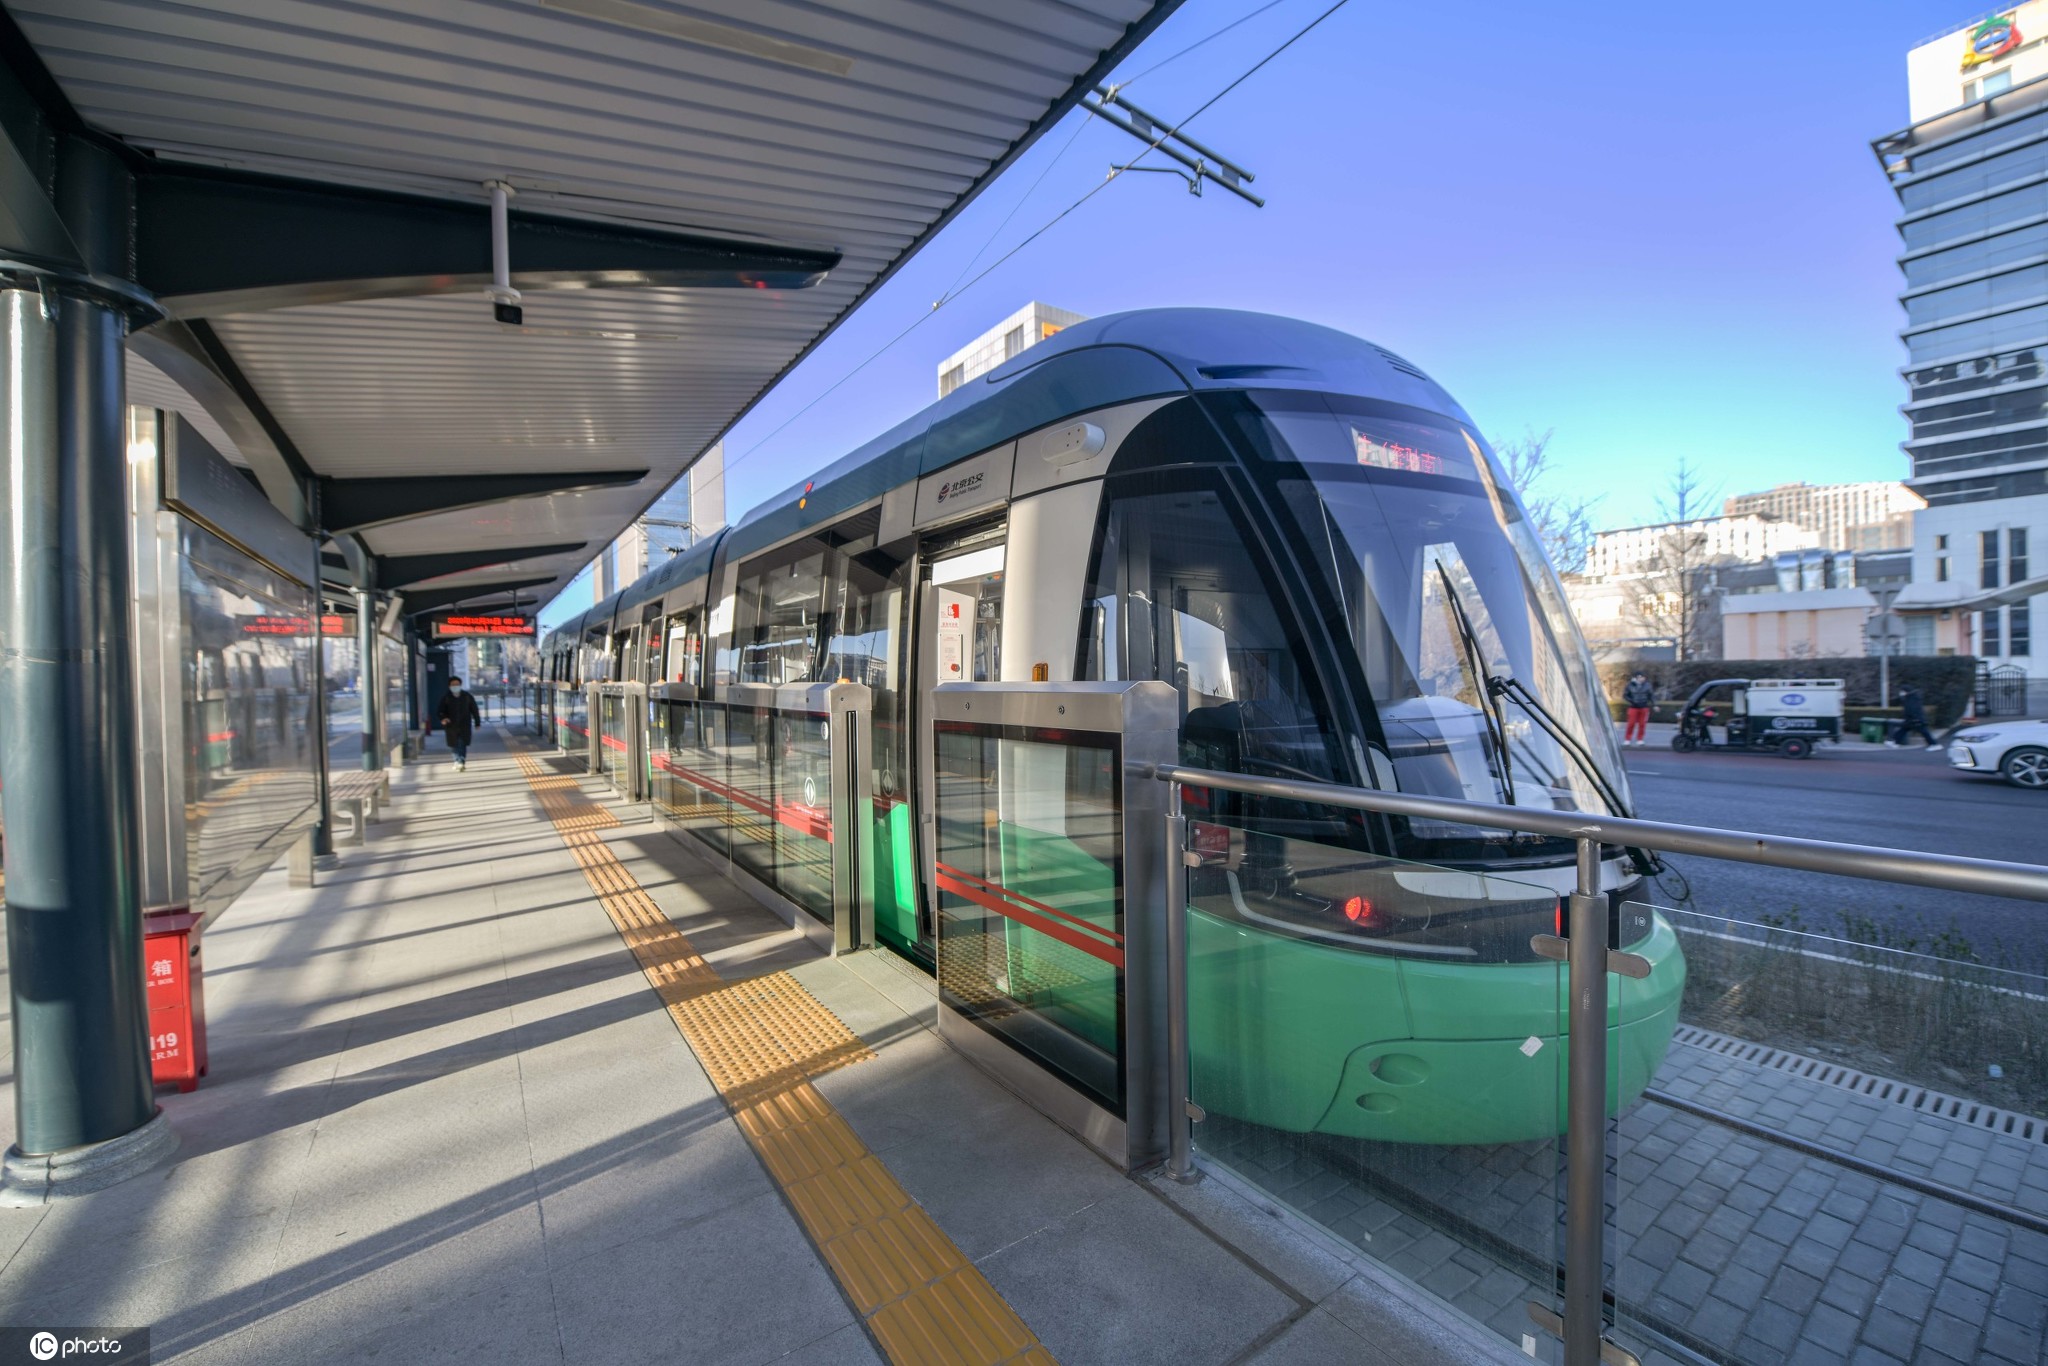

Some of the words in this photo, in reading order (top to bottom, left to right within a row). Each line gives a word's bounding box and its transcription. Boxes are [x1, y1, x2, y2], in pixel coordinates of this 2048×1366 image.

[951, 472, 984, 492] 北京公交
[151, 960, 172, 976] 箱
[149, 1032, 178, 1051] 119
[151, 1048, 179, 1061] RM
